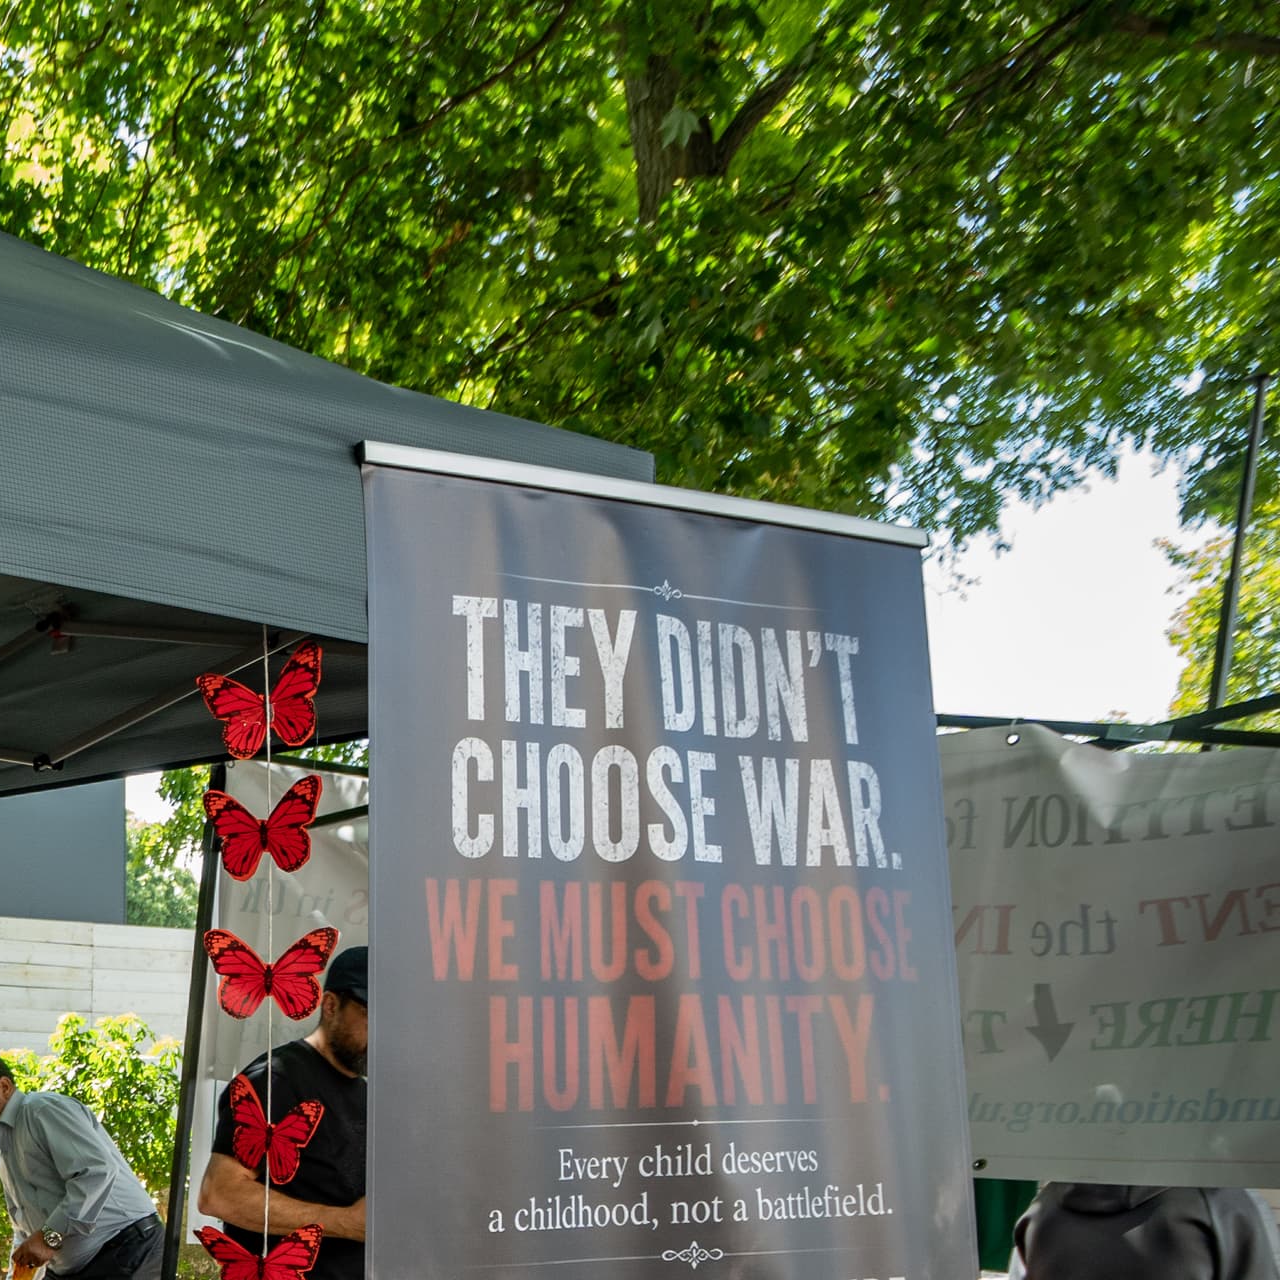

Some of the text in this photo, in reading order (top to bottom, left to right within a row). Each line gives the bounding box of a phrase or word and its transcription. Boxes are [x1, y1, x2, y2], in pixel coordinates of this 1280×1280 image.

[452, 594, 860, 746] THEY DIDN'T
[450, 736, 904, 871] CHOOSE WAR.
[425, 878, 919, 985] WE MUST CHOOSE
[489, 992, 890, 1114] HUMANITY.
[487, 1182, 894, 1234] a childhood, not a battlefield.
[557, 1141, 819, 1189] Every child deserves
